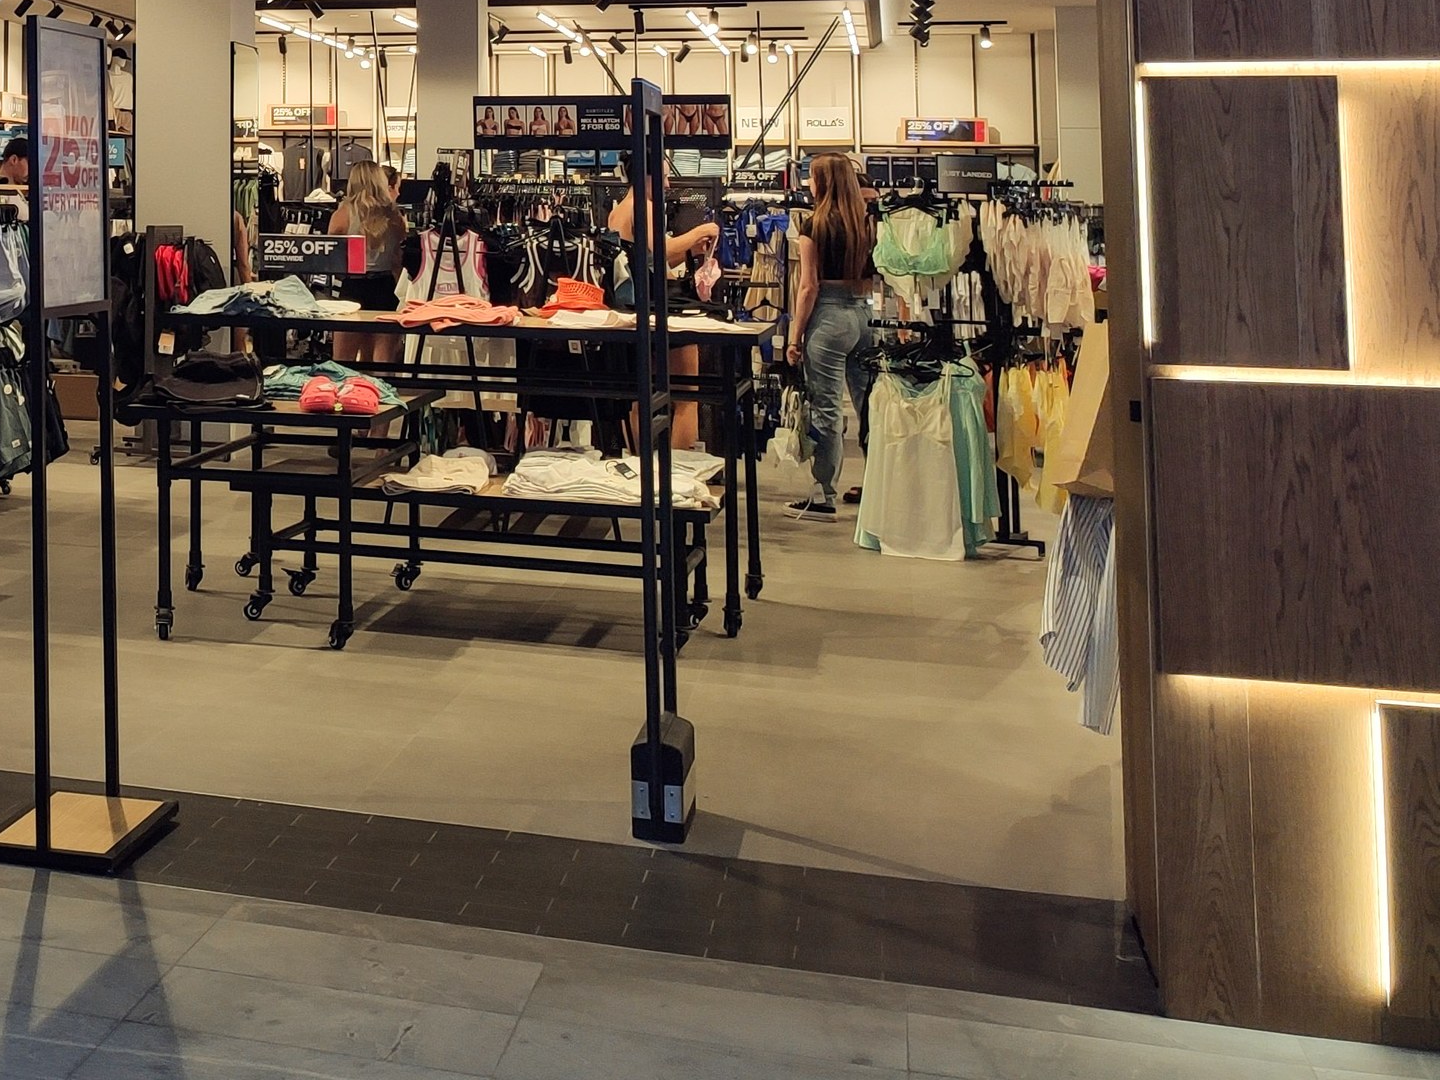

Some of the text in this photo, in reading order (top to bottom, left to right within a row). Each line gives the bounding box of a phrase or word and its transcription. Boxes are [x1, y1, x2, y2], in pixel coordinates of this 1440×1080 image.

[273, 108, 293, 117] 25%
[605, 123, 620, 131] $50
[806, 118, 845, 128] ROLLA'S
[908, 121, 932, 130] 25%
[81, 168, 99, 188] OFF
[735, 172, 778, 181] 25% OFF
[961, 171, 992, 179] LANDED
[264, 240, 298, 254] 25%
